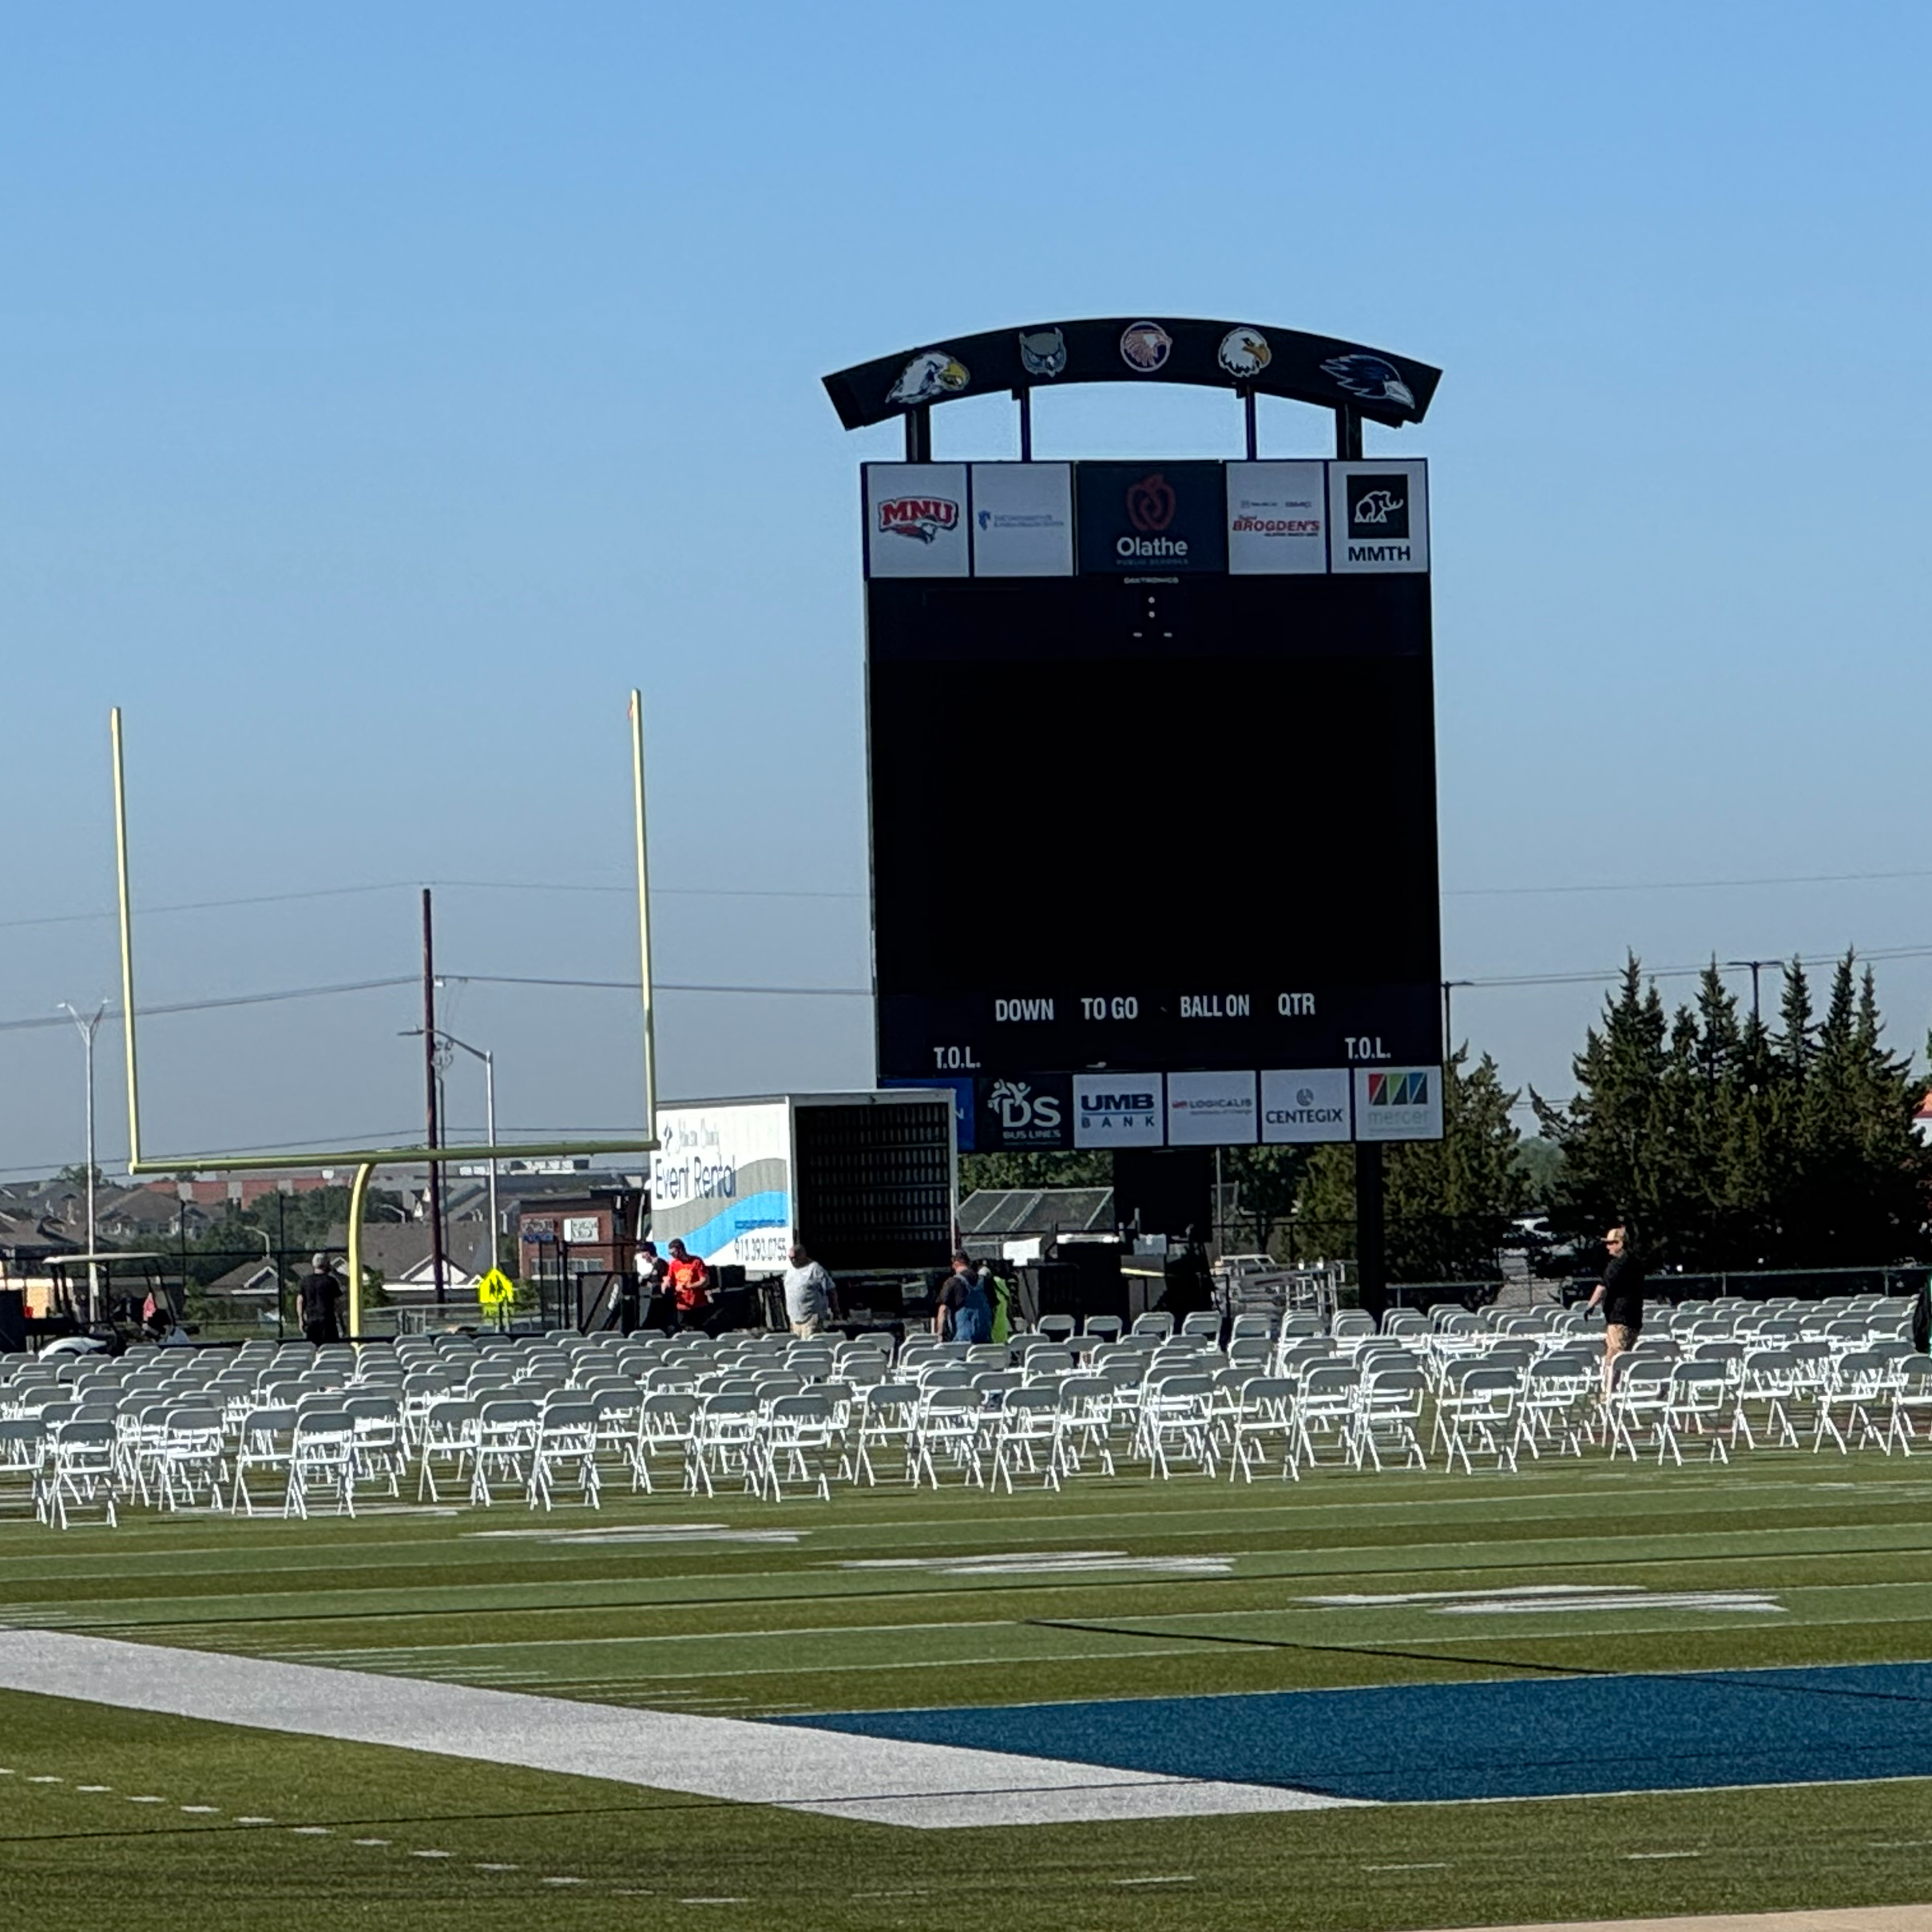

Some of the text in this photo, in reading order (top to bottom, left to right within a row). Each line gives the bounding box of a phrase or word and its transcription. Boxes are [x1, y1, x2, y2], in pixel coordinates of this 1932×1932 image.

[881, 498, 954, 526] MNU
[1232, 520, 1319, 531] BROGDEN'S
[1117, 537, 1188, 557] Olathe
[1348, 545, 1410, 561] MMTH
[995, 998, 1054, 1022] DOWN
[1081, 997, 1138, 1020] TO GO
[1180, 994, 1250, 1018] BALL ON
[1278, 993, 1315, 1016] QTR
[934, 1046, 981, 1069] T.O.L.
[1345, 1037, 1391, 1060] T.O.L.
[1002, 1096, 1061, 1127] DS
[1081, 1093, 1155, 1111] UMB
[1081, 1116, 1155, 1129] BANK
[1266, 1109, 1343, 1124] CENTEGIX
[1368, 1110, 1428, 1125] mercer
[1002, 1129, 1061, 1139] BUS LINES
[656, 1154, 736, 1200] Event Rental
